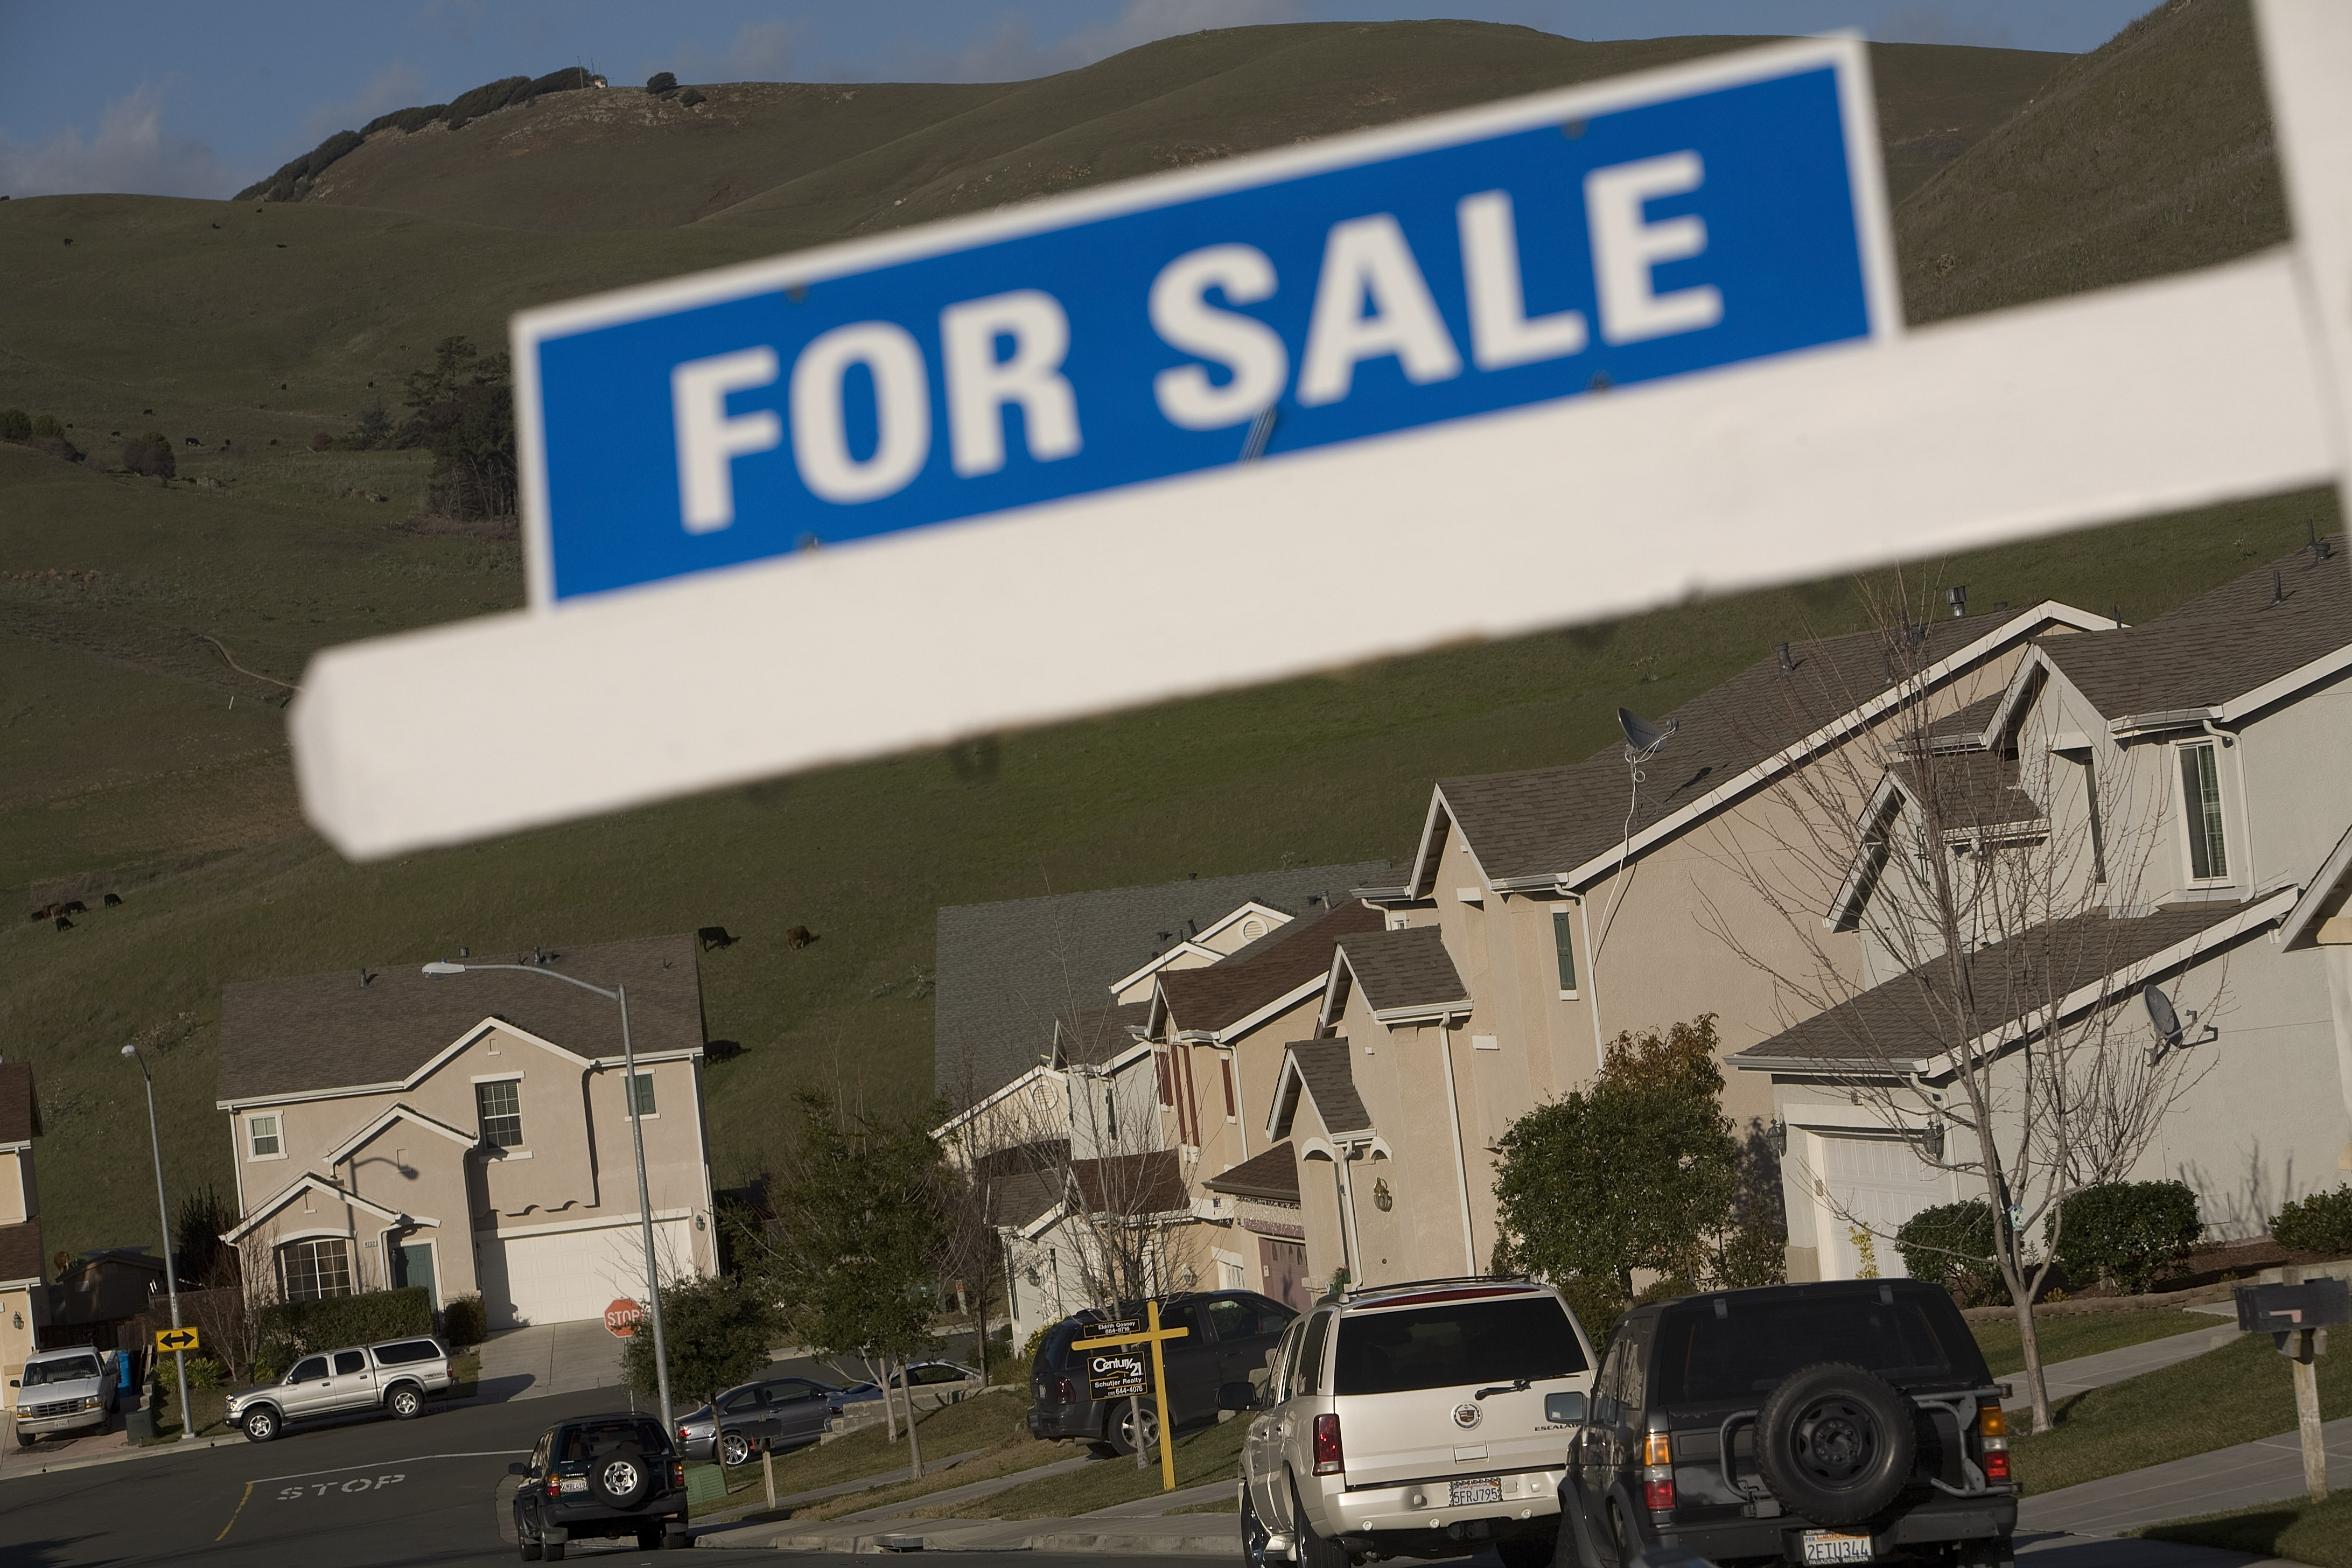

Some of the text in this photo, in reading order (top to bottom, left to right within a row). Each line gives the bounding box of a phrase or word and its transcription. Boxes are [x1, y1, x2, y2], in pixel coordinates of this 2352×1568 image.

[670, 150, 1725, 536] FOR SALE
[607, 1310, 640, 1326] STOP
[1093, 1357, 1133, 1373] Century
[1130, 1362, 1142, 1377] 21
[1095, 1380, 1121, 1388] Schutjer
[1116, 1385, 1143, 1395] 644-4076
[276, 1474, 405, 1500] STOP
[1454, 1487, 1497, 1504] 5FRJ795
